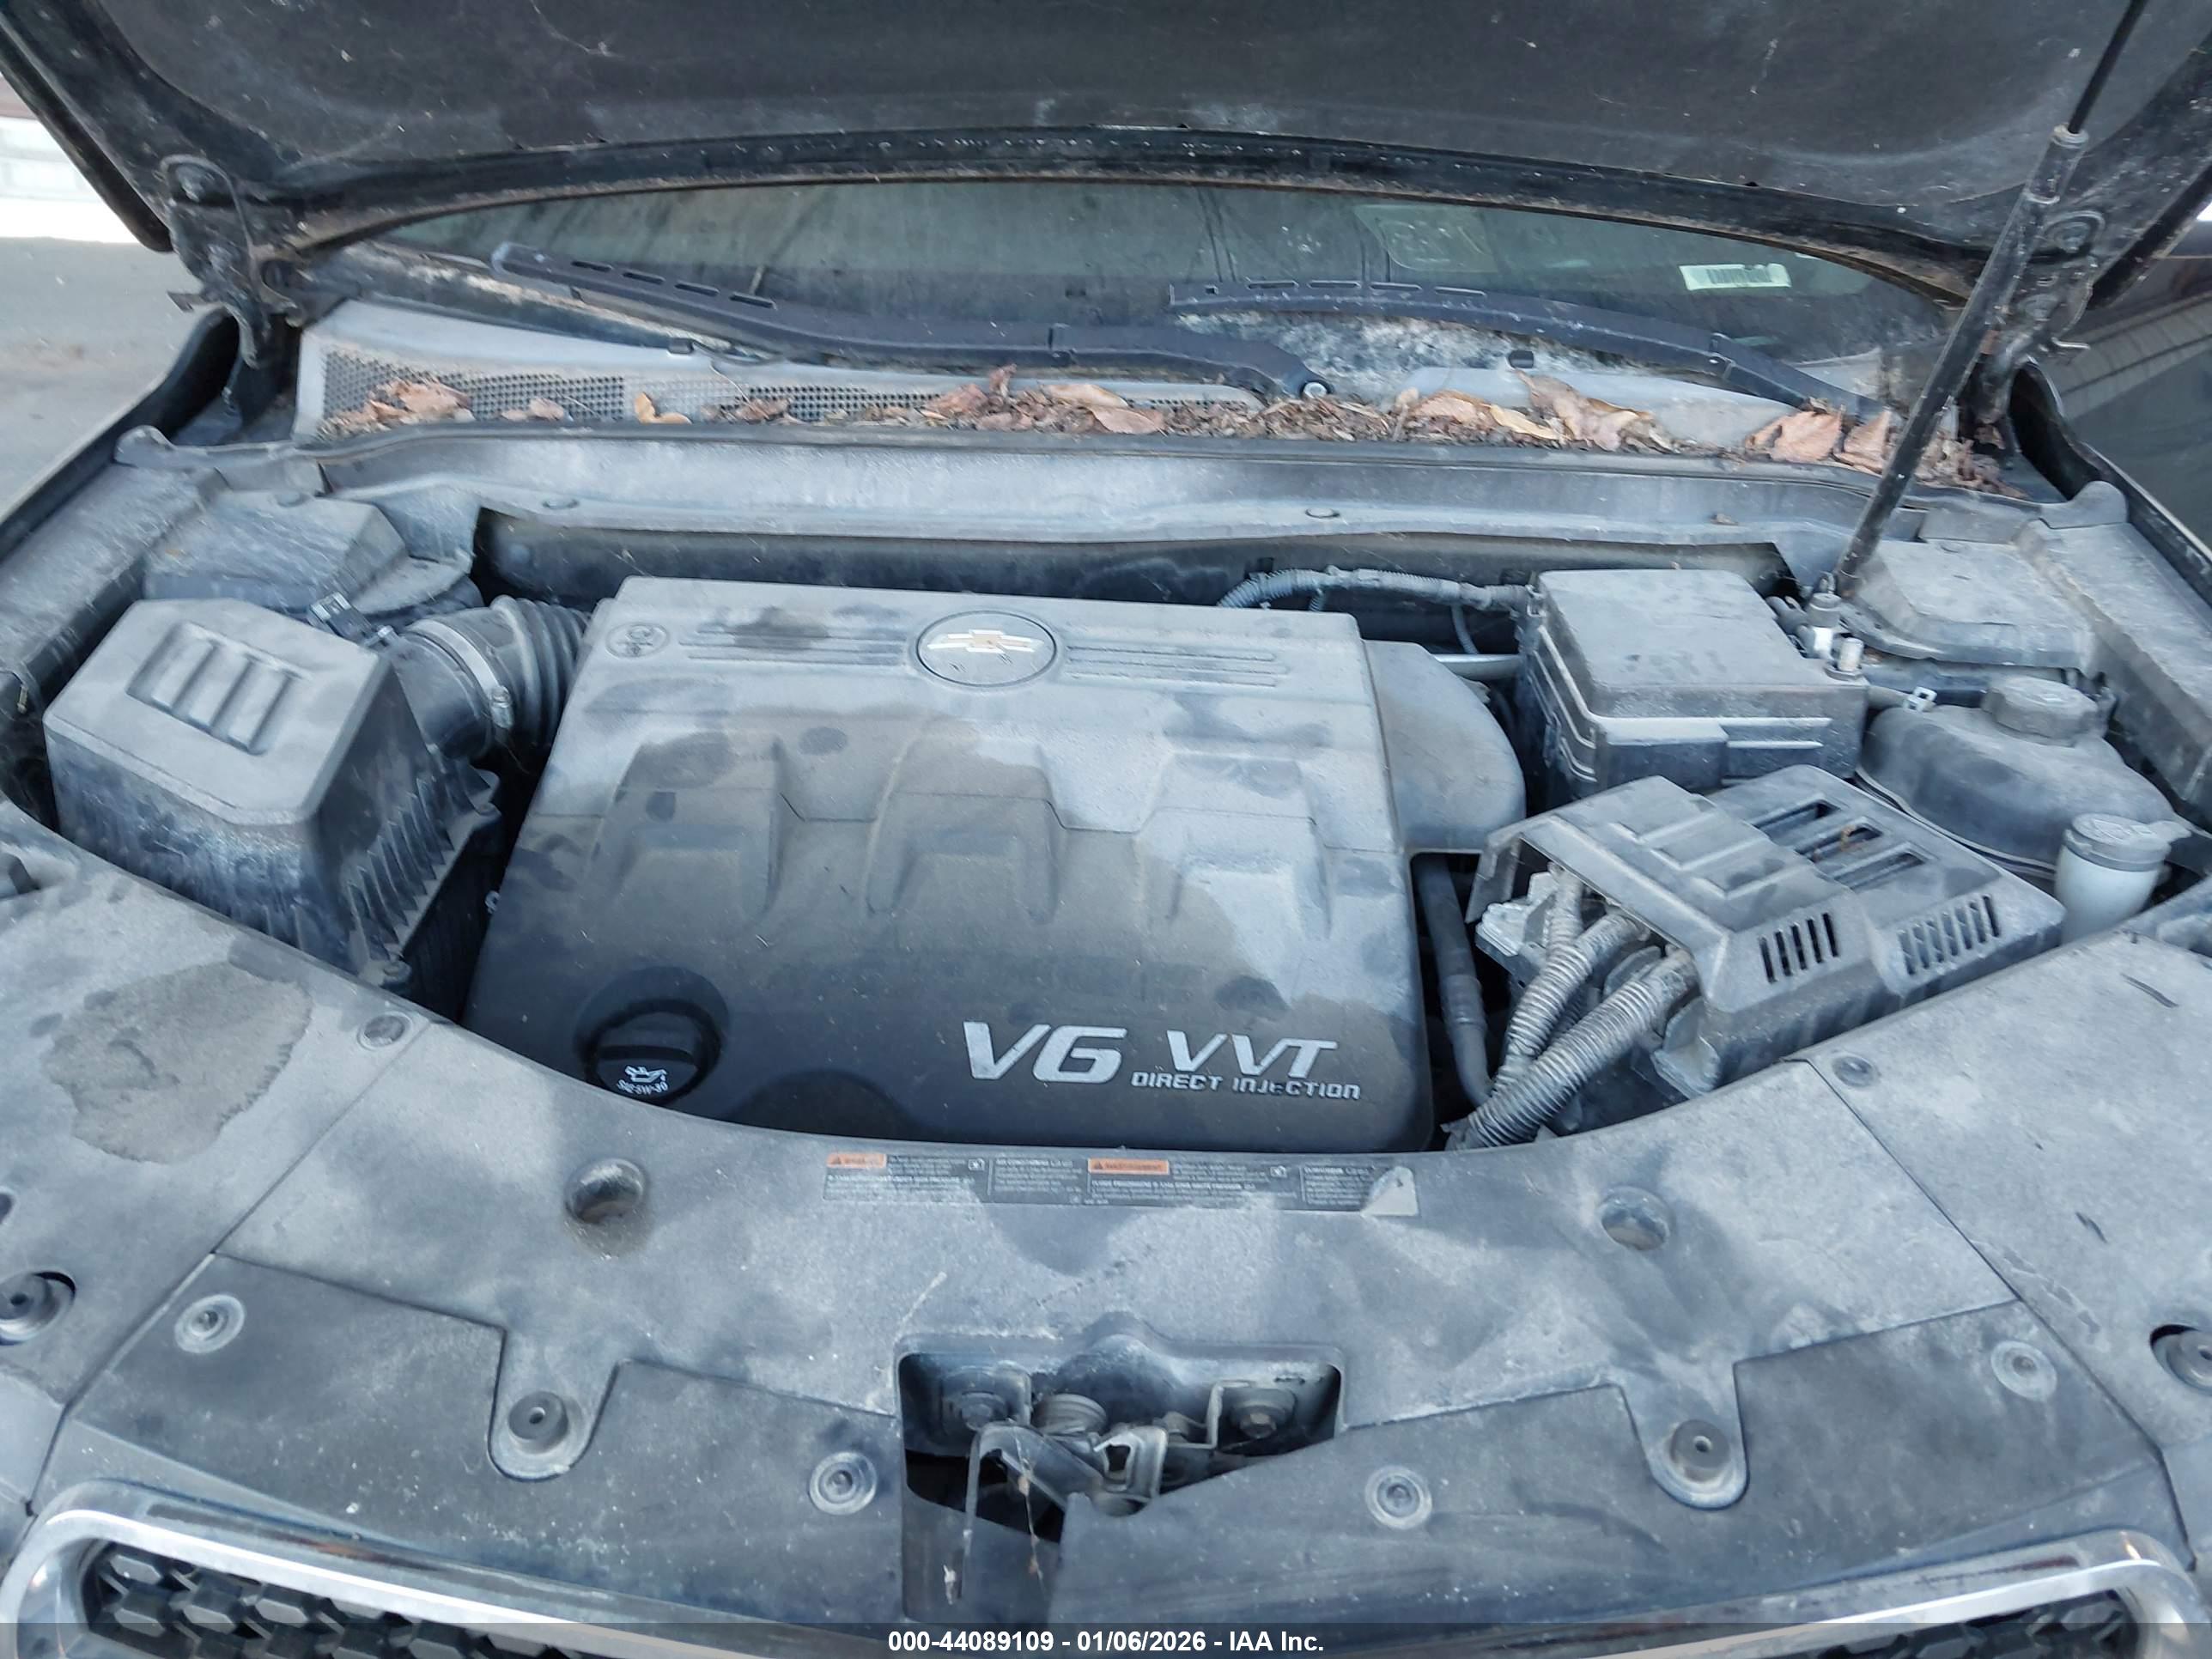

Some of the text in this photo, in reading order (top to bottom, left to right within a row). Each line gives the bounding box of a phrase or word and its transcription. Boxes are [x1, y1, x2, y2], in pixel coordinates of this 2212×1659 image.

[963, 1021, 1339, 1084] V6 VVT
[1130, 1071, 1362, 1100] DIRECT INJECTION
